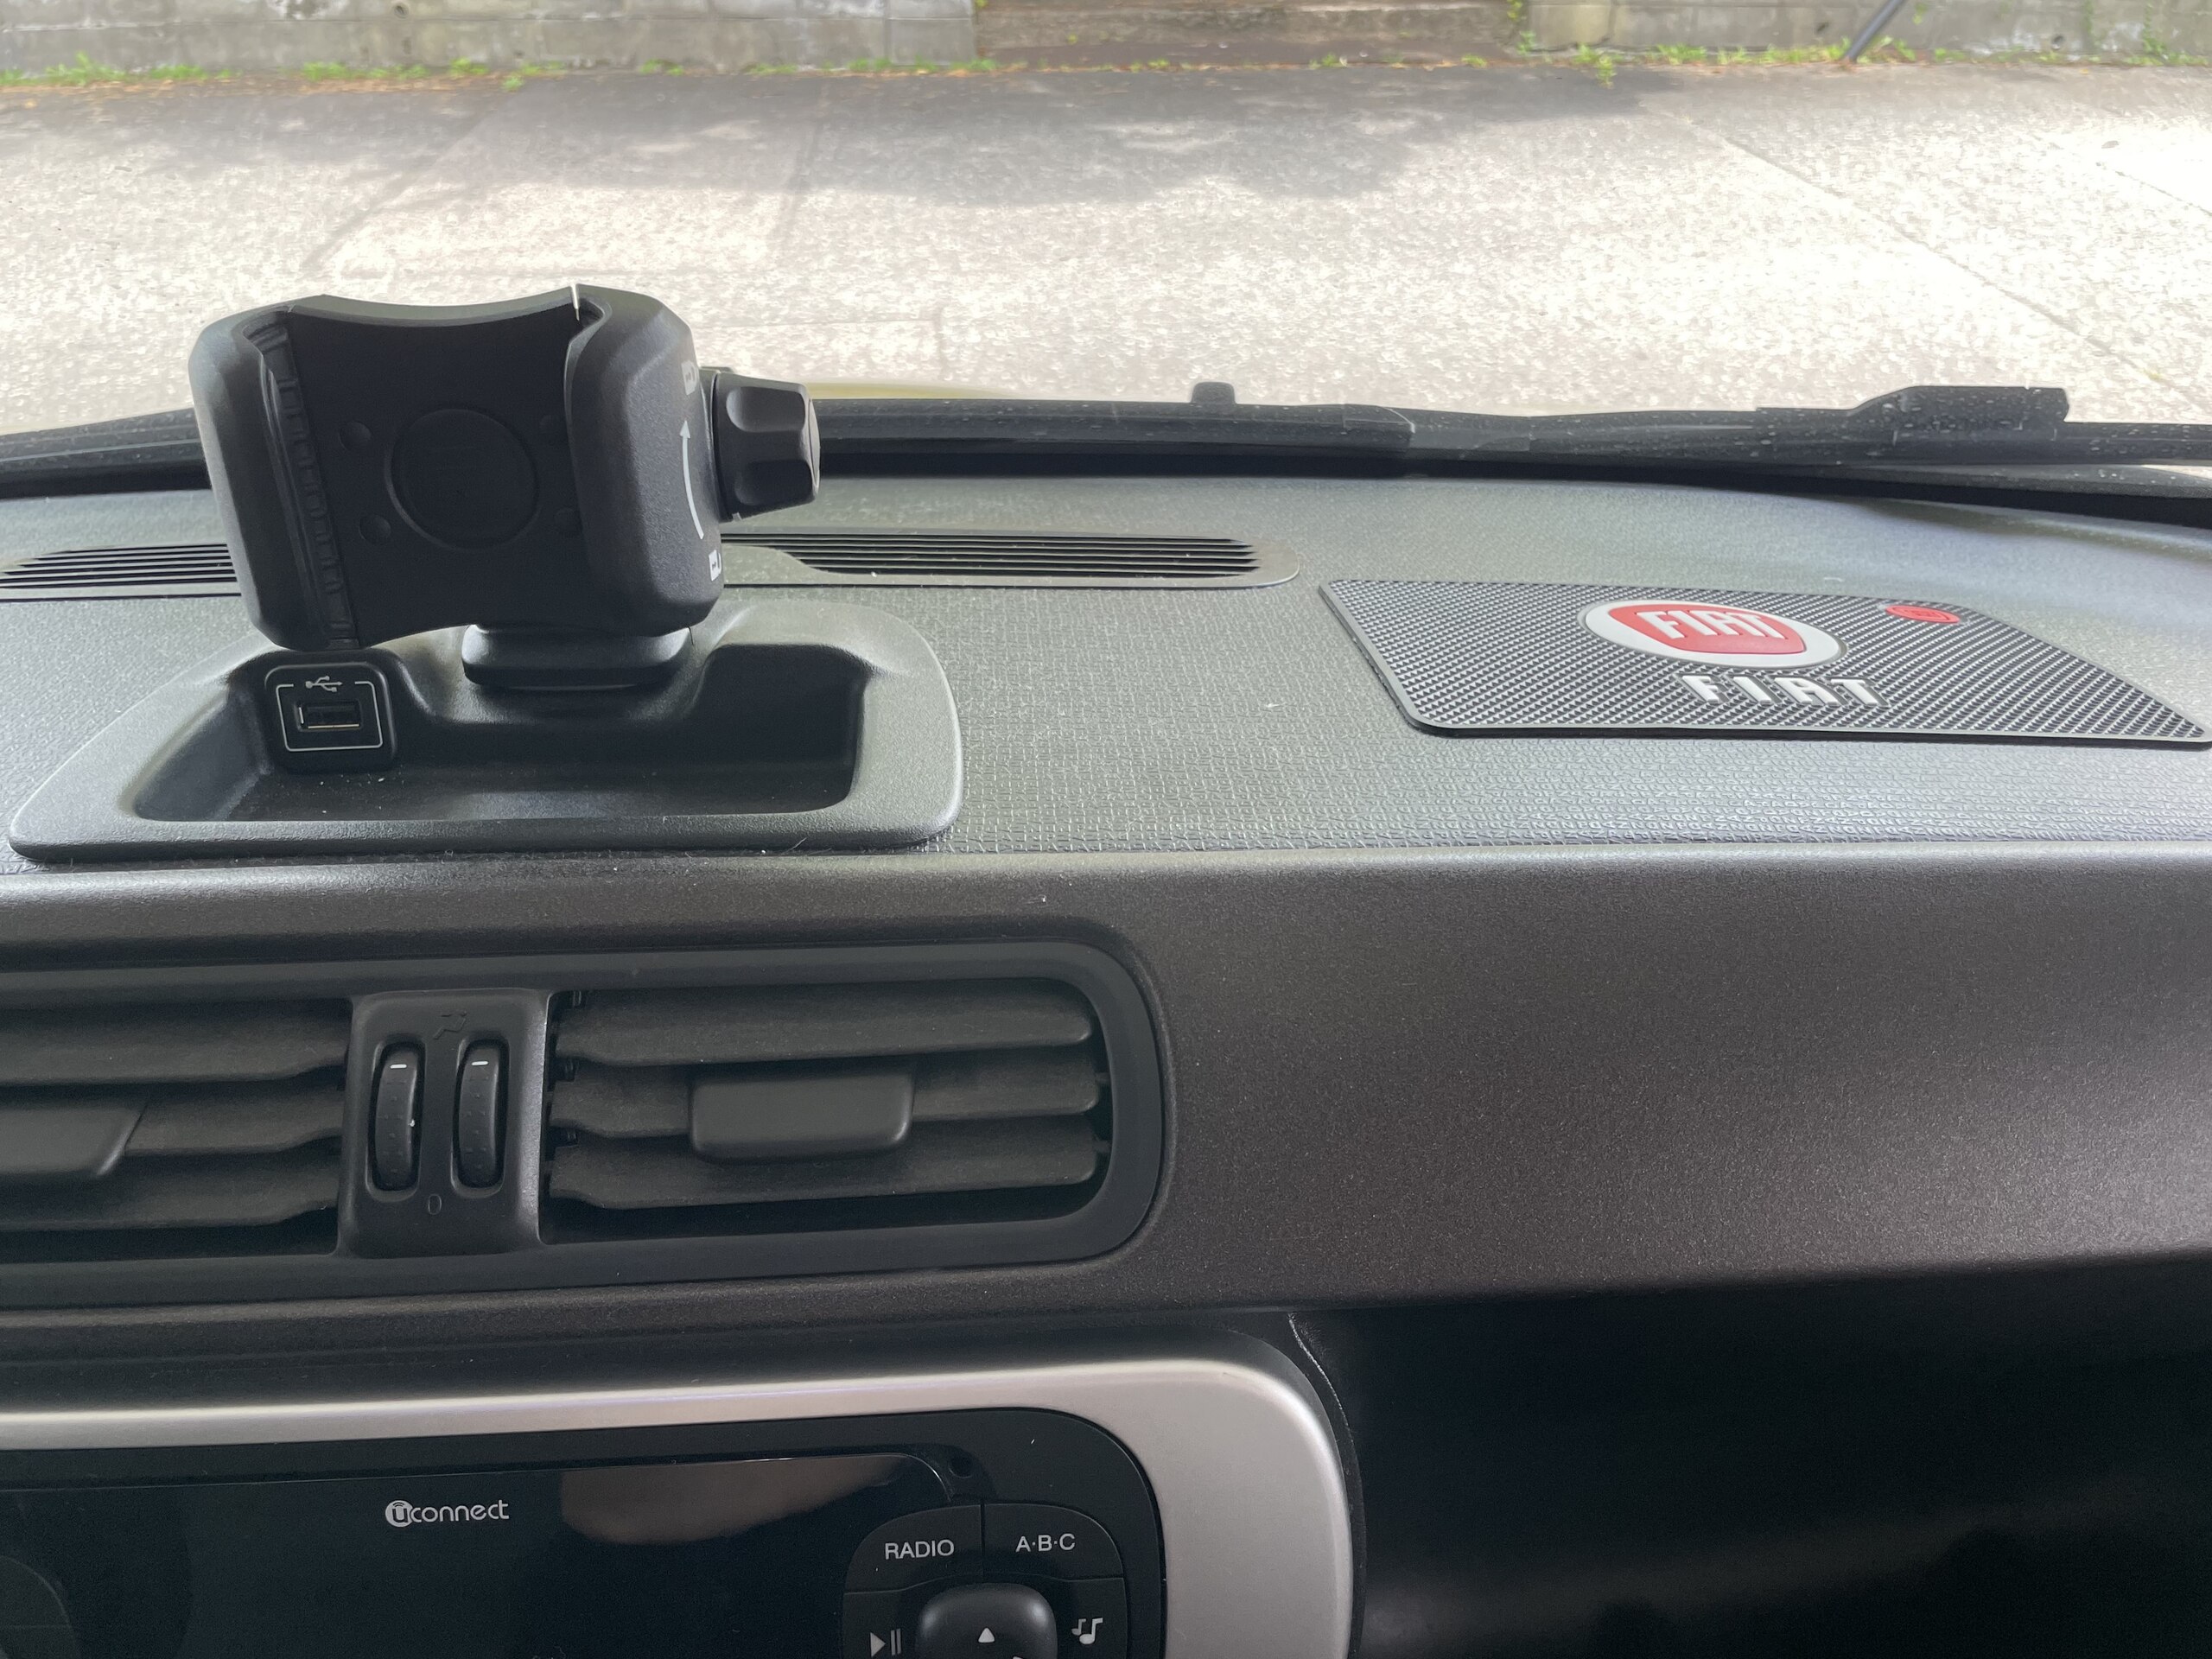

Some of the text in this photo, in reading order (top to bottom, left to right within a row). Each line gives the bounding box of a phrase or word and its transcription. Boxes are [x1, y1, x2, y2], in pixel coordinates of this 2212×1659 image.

[1635, 609, 1789, 641] FIAT
[1681, 674, 1879, 707] FIAT
[385, 1499, 511, 1529] uconnect
[884, 1538, 956, 1560] RADIO
